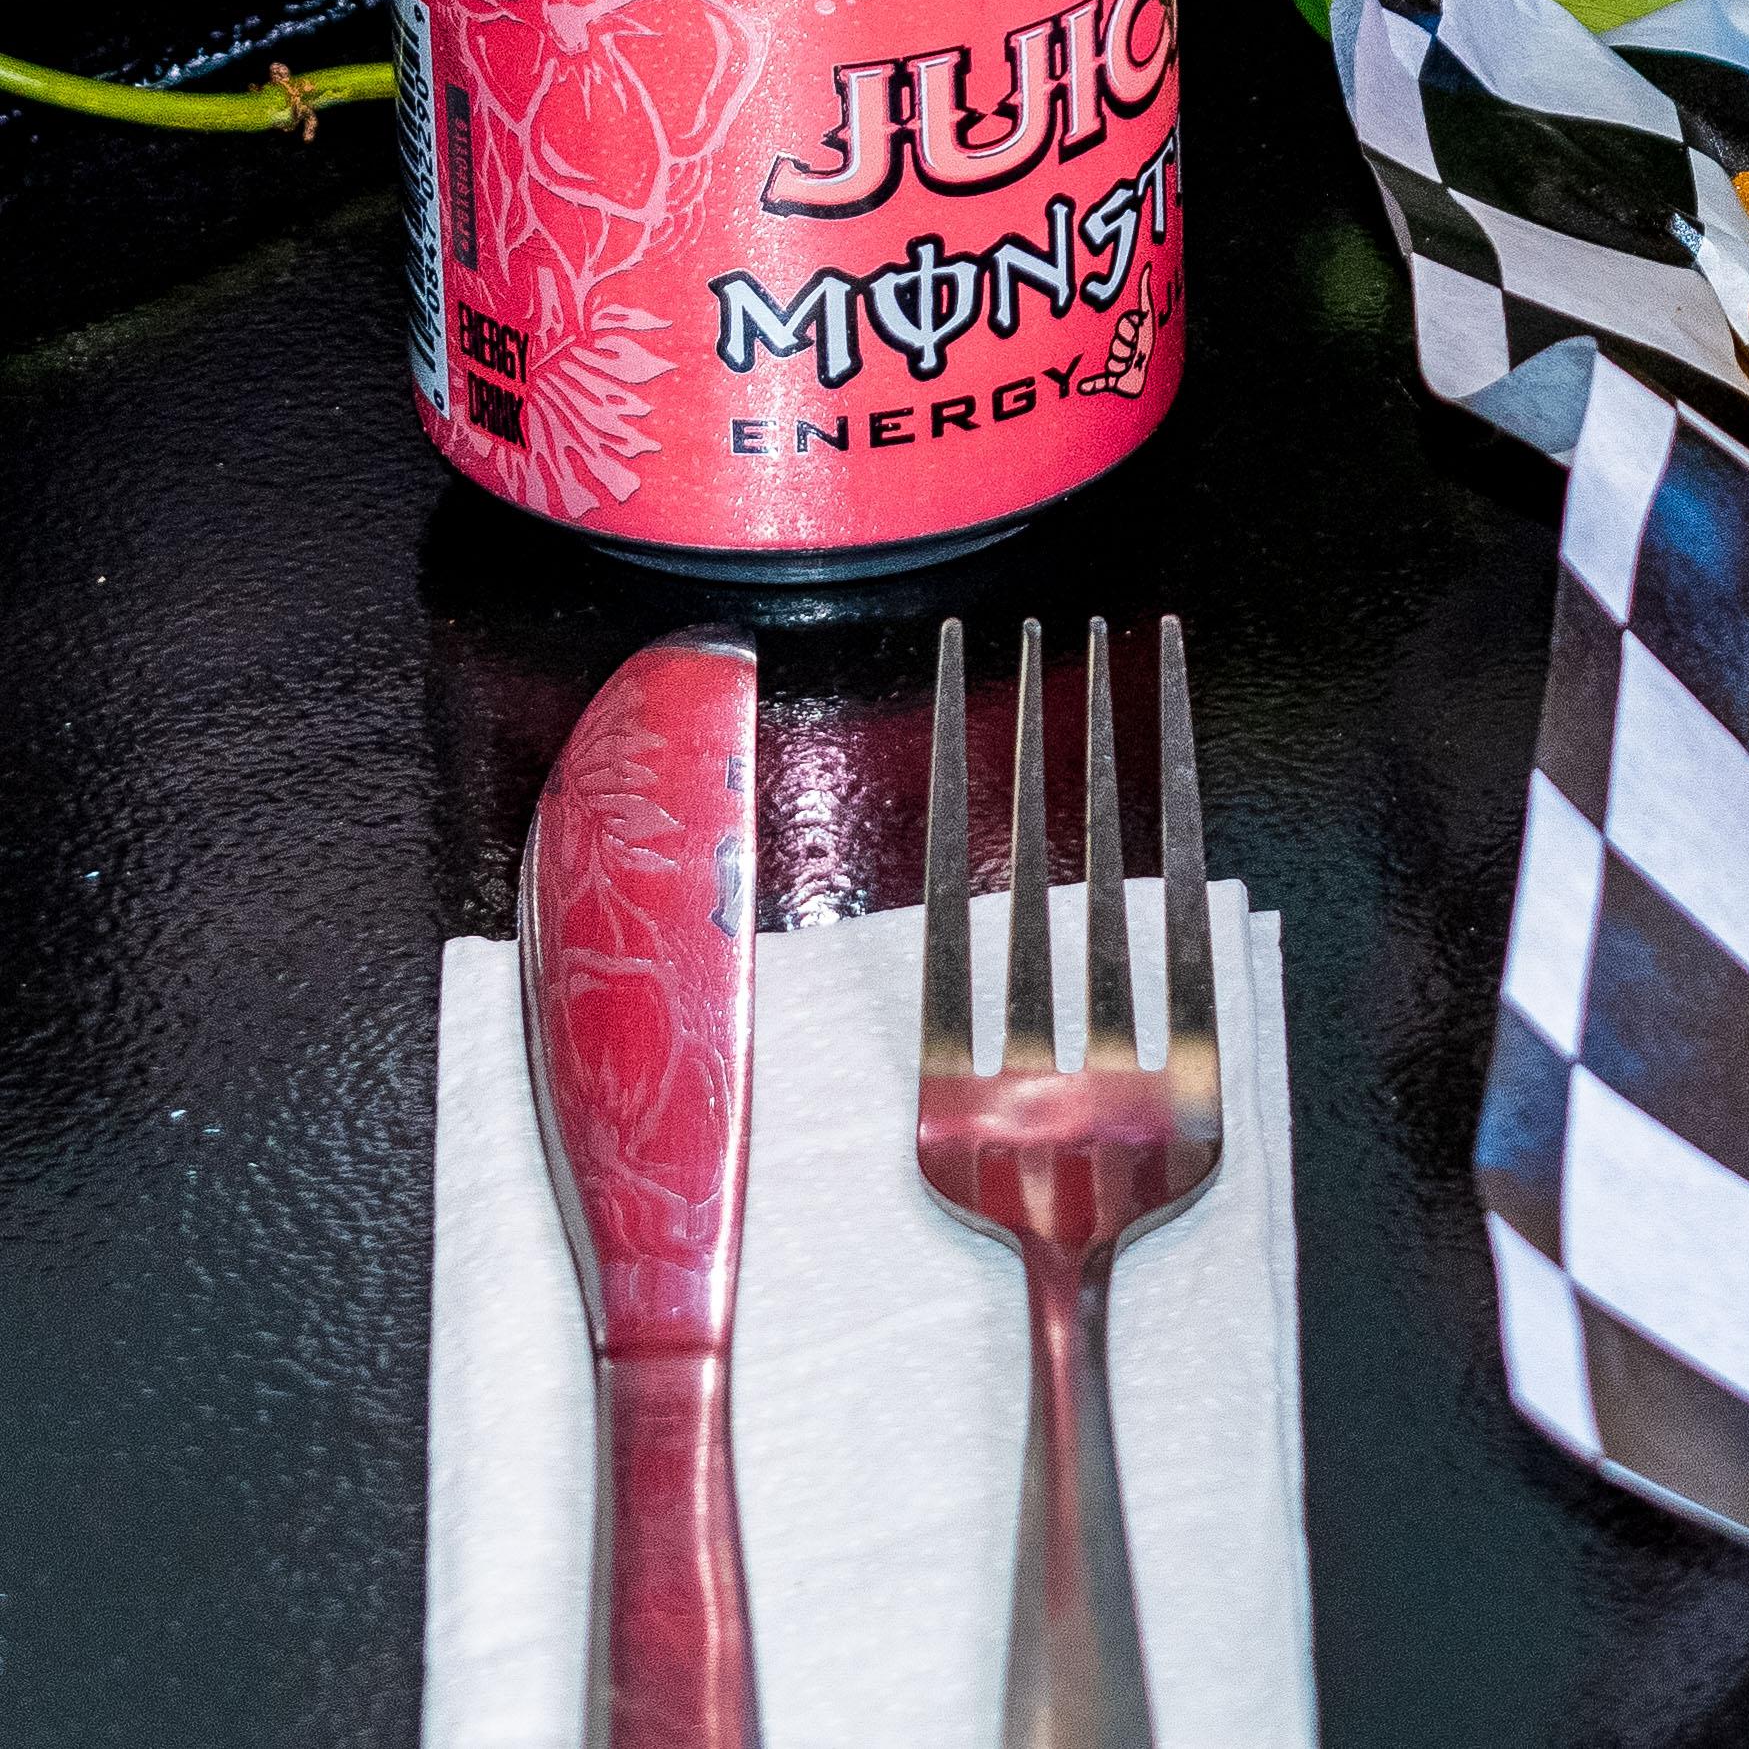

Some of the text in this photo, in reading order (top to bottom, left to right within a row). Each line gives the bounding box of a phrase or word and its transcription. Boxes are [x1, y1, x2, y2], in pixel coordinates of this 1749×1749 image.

[709, 122, 1183, 389] MONST
[458, 300, 530, 385] ENERGY
[467, 369, 527, 450] DRINK
[731, 354, 1085, 456] ENERGY
